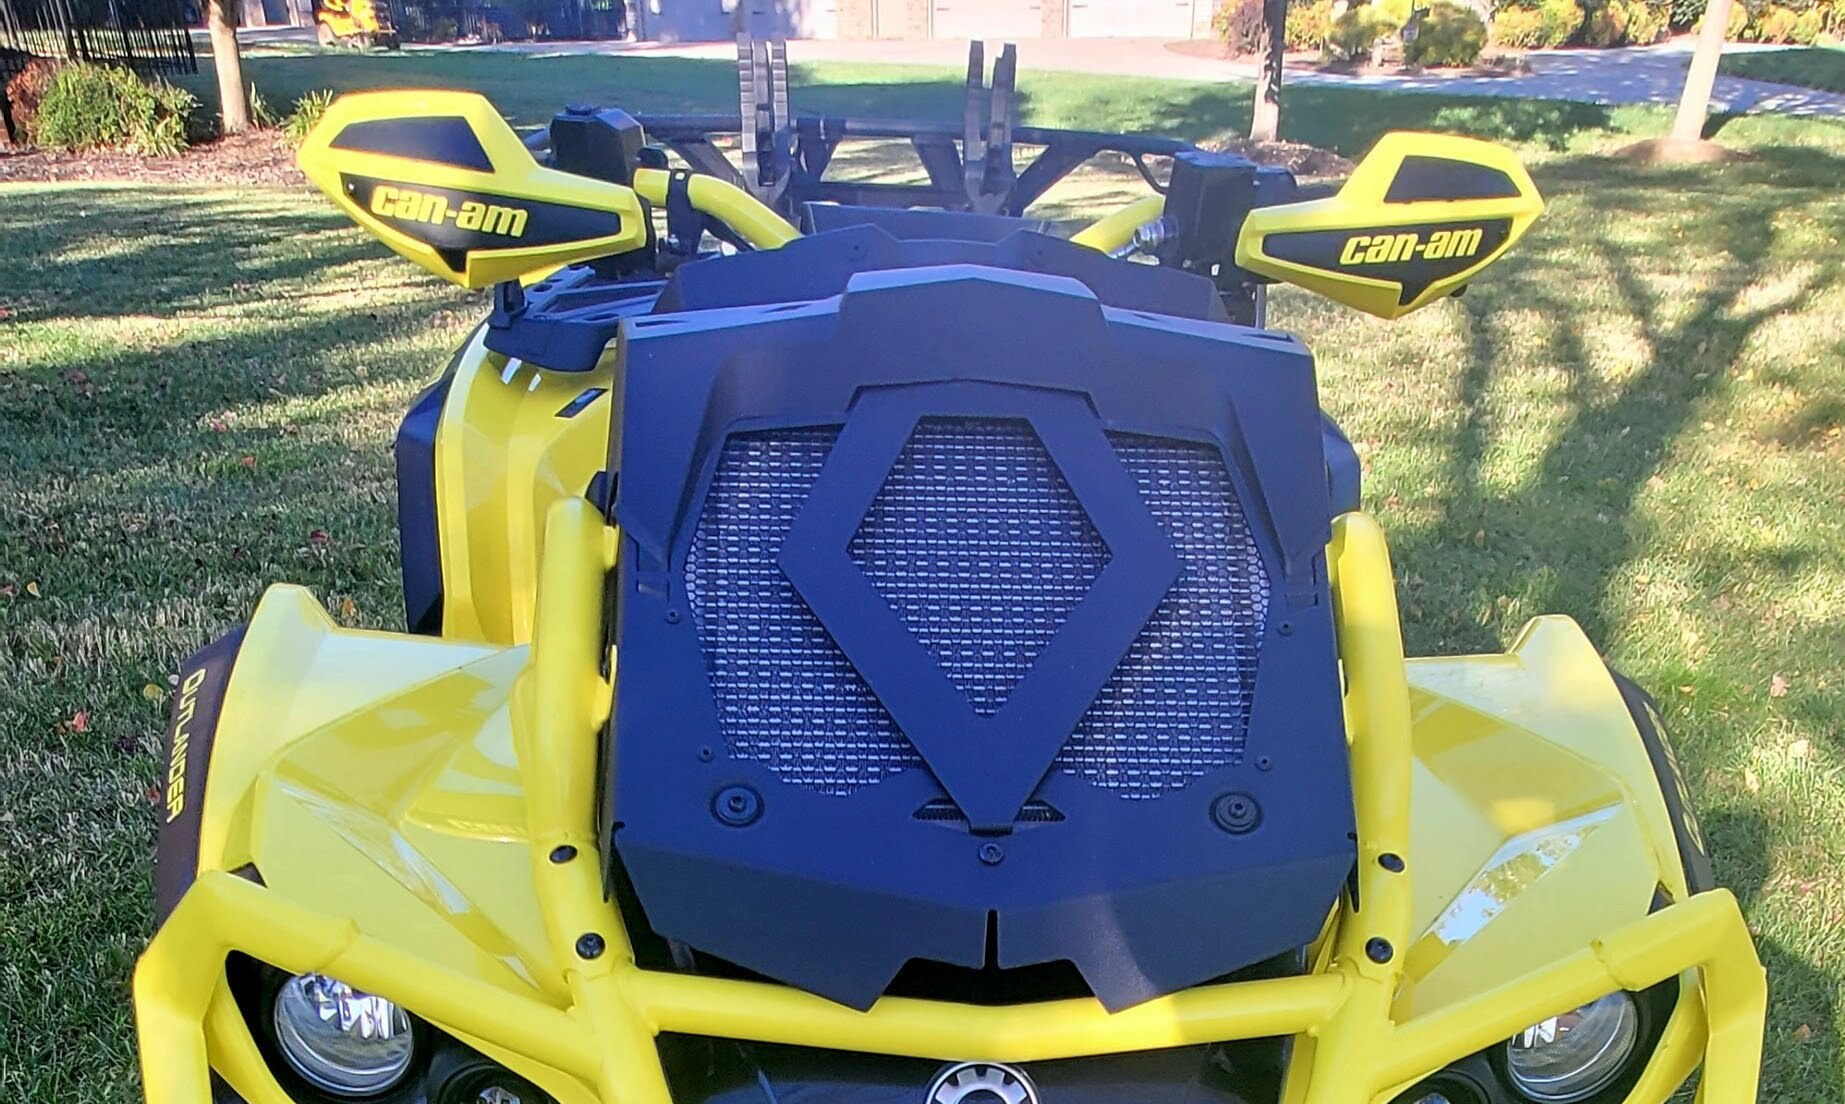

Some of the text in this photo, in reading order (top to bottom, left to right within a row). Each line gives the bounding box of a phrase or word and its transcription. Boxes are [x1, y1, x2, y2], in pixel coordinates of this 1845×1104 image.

[371, 185, 528, 237] can-am
[1340, 229, 1482, 265] can-am
[166, 668, 207, 824] OUTLANDER
